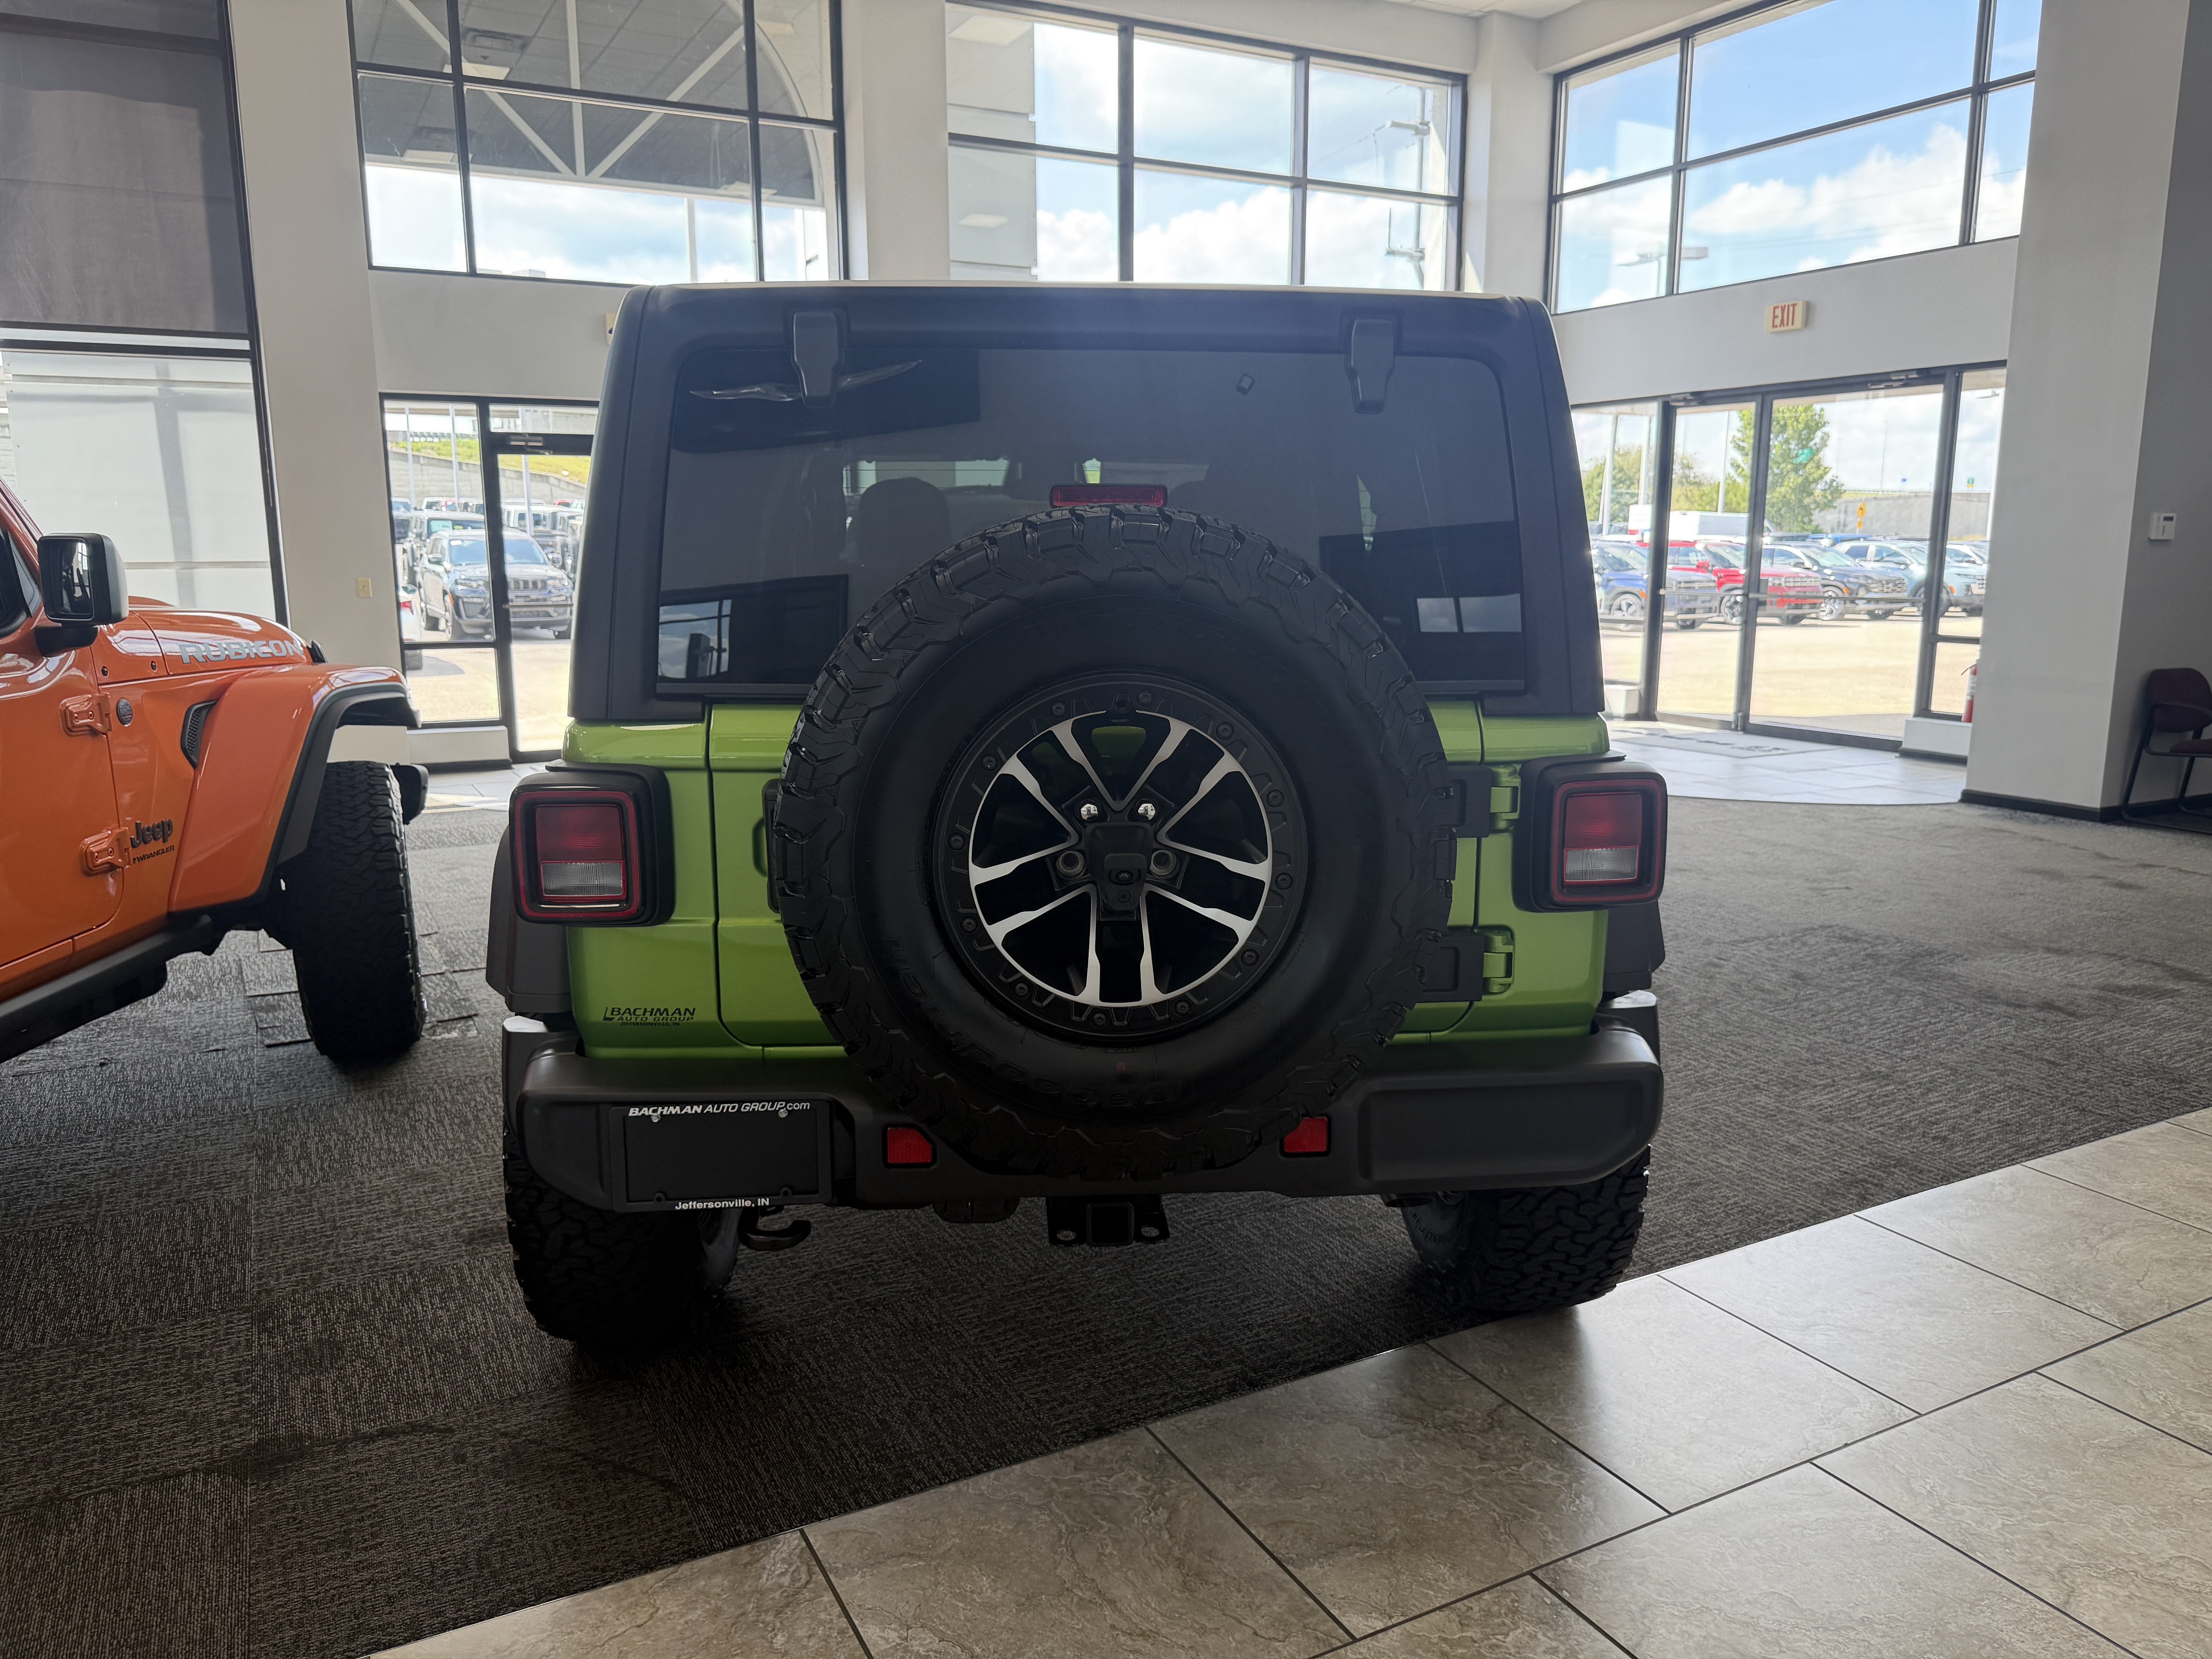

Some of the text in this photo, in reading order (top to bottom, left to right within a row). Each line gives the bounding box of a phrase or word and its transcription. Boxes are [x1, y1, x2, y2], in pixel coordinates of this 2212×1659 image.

[1772, 303, 1797, 328] EXIT
[179, 639, 304, 664] RUBICON
[130, 819, 173, 848] Jeep
[136, 845, 175, 862] WRANGLER
[610, 1007, 696, 1016] BACHMAN
[628, 1105, 702, 1116] BACHMAN
[703, 1103, 738, 1113] AUTO
[675, 1198, 769, 1210] Jeffersonville, IN
